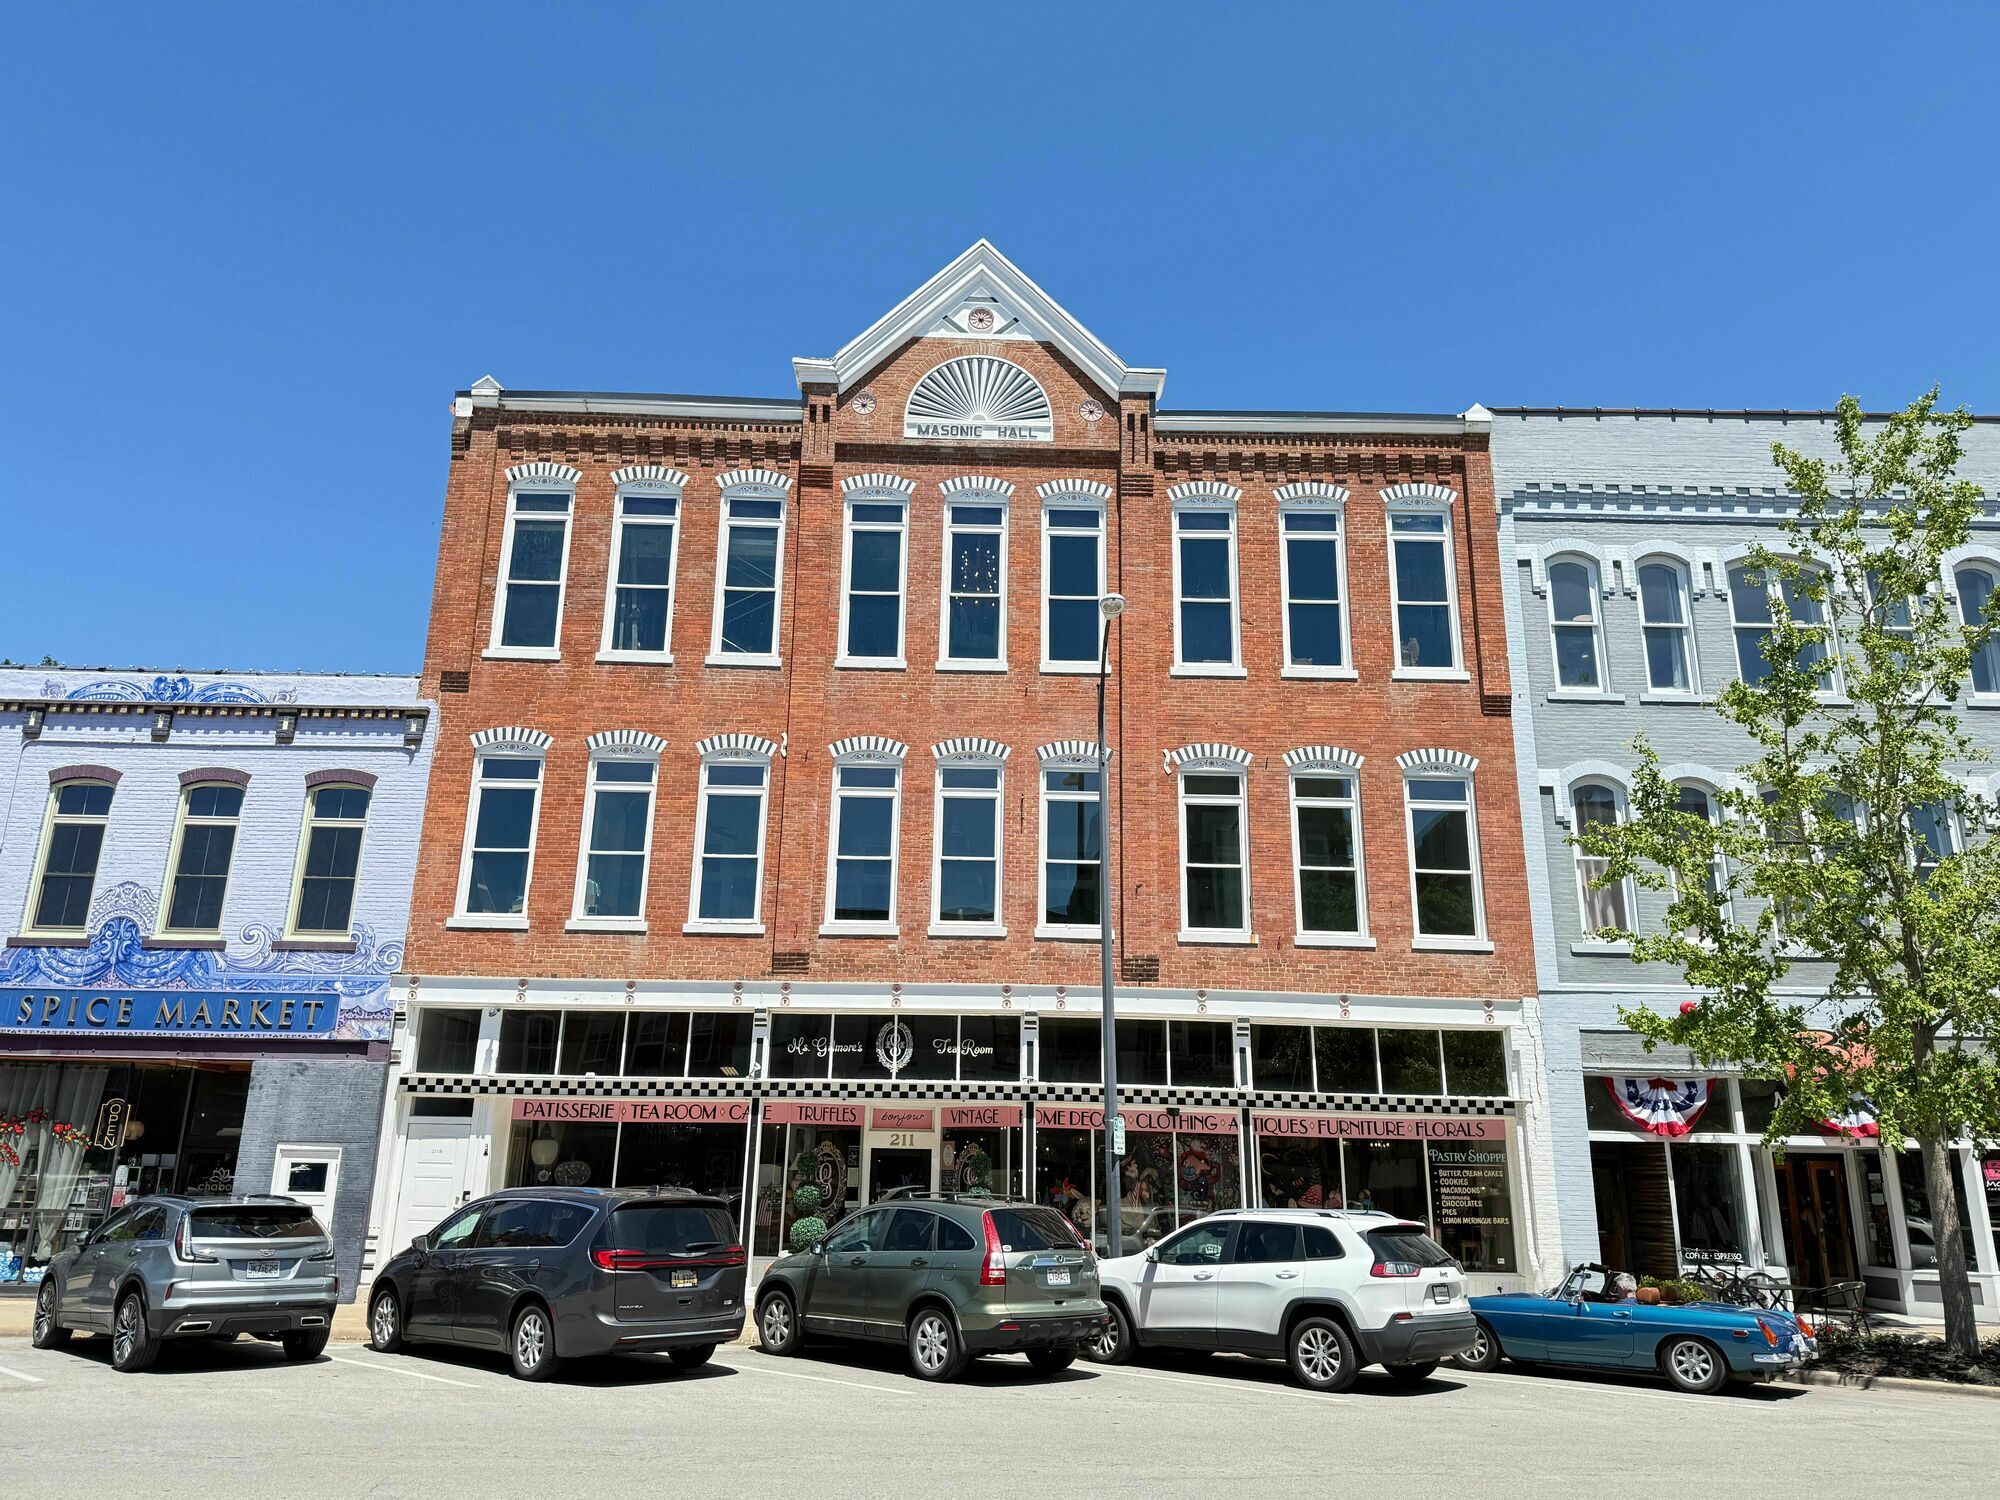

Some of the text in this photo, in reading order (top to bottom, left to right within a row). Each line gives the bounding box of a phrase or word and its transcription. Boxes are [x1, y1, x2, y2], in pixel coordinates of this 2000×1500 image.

[917, 424, 1037, 438] MASONIC HALL
[17, 995, 324, 1029] SPICE MARKET
[811, 1036, 863, 1058] Gmore's
[932, 1038, 994, 1057] Tea Room
[522, 1102, 857, 1123] PATISSERIE TEA ROOM CAE TRUFFLES
[881, 1112, 925, 1127] bonjour
[104, 1104, 121, 1146] OPEN
[950, 1108, 999, 1125] VINTAGE
[1069, 1111, 1126, 1128] DEC
[1136, 1113, 1218, 1131] CLOTHING
[1228, 1116, 1308, 1135] ATIQUES
[1317, 1119, 1406, 1137] FURNITURE
[1415, 1121, 1485, 1138] FLORALS
[890, 1133, 914, 1146] 211
[1493, 1217, 1509, 1225] BARS
[1713, 1252, 1742, 1260] ESPRESSO
